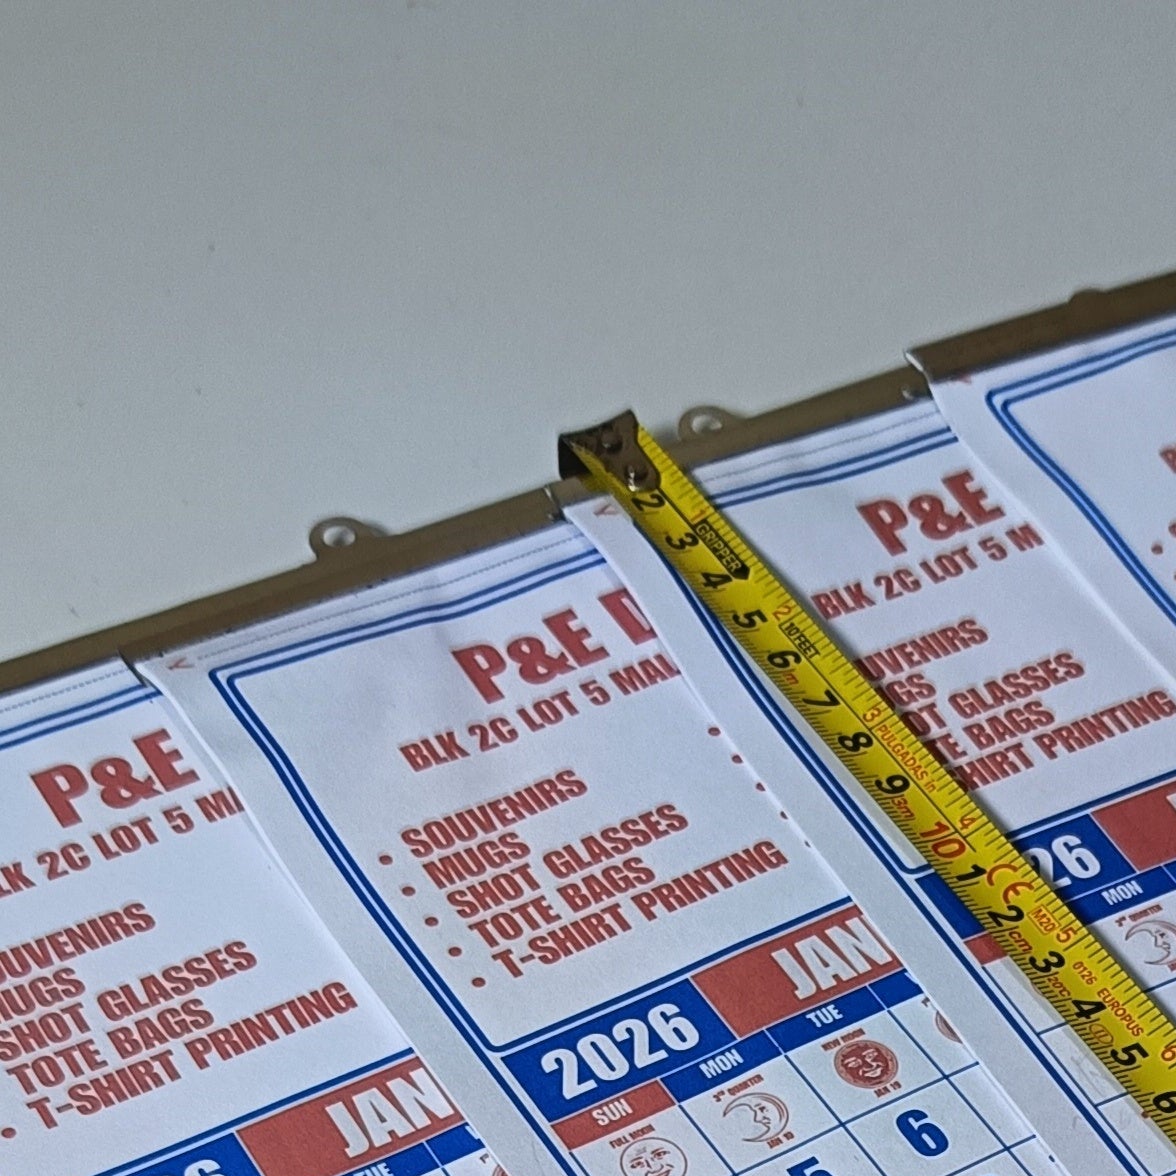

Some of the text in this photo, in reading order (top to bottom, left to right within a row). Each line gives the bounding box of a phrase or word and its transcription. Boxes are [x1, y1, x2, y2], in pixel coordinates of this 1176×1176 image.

[696, 523, 741, 577] GRIPPER
[856, 469, 1005, 557] P&E
[811, 583, 876, 620] BLK
[874, 568, 922, 601] 2C
[919, 547, 978, 584] LOT
[979, 536, 1008, 561] 5
[451, 608, 609, 704] P&E
[796, 634, 820, 660] FEET
[948, 652, 1085, 719] GLASSES
[400, 680, 610, 772] BLK 2C LOT 5
[877, 724, 929, 782] PULGADAS
[963, 701, 1055, 751] BAGS
[30, 728, 200, 828] P&E
[401, 770, 587, 858] SOUVENIRS
[37, 806, 194, 881] 2C LOT 5
[422, 832, 531, 889] MUGS
[446, 804, 689, 918] SHOT GLASSES
[919, 821, 965, 858] 10
[469, 857, 656, 948] TOTE BAGS
[492, 839, 788, 978] T-SHIRT PRINTING
[1030, 907, 1055, 934] M20
[1101, 880, 1144, 906] MON
[1008, 929, 1033, 954] cm
[1073, 961, 1097, 985] 0126
[0, 941, 257, 1061] SHOT GLASSES
[1097, 987, 1144, 1037] EUROPUS
[7, 999, 214, 1094] TOTE BAGS
[27, 982, 358, 1129] T-SHIRT PRINTING
[540, 1003, 702, 1101] 2026
[591, 1005, 844, 1126] SUN MON TUE
